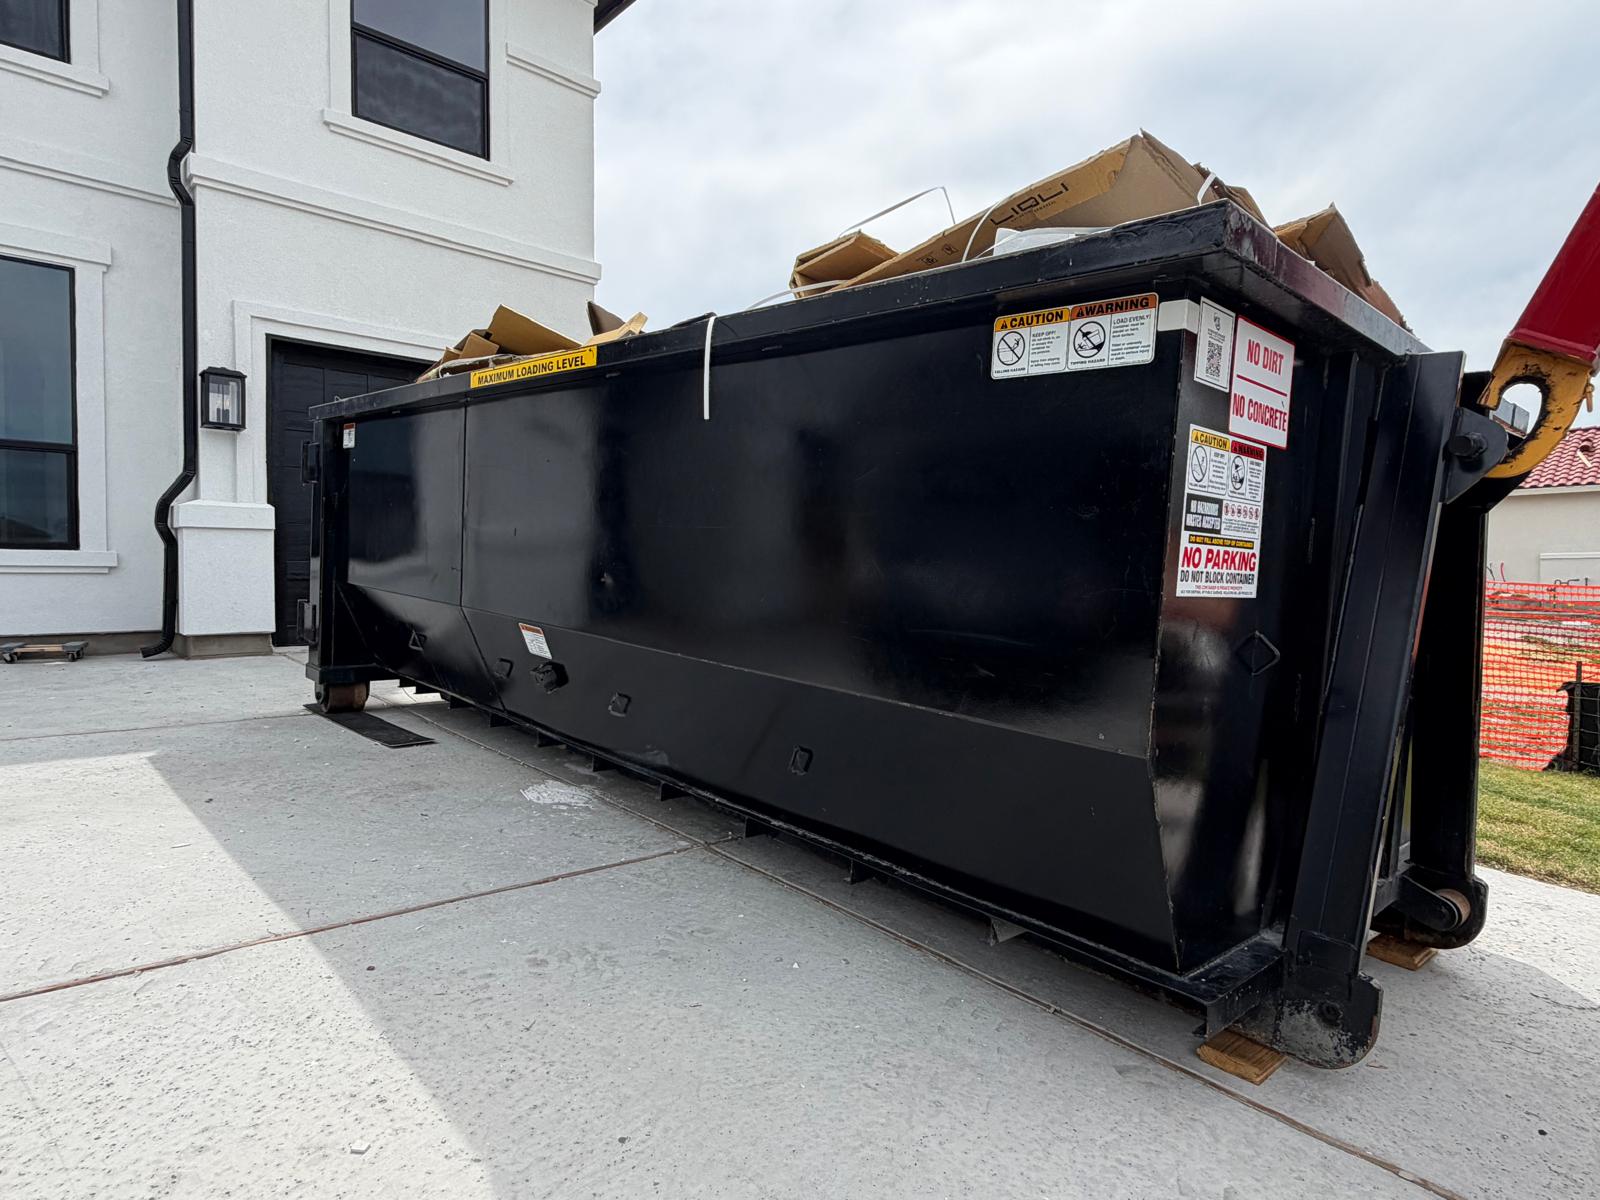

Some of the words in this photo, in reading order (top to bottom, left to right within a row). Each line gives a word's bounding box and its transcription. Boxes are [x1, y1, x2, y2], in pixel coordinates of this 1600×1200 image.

[1085, 297, 1149, 315] WARNING
[1010, 311, 1064, 328] CAUTION
[1247, 339, 1260, 366] NO
[1262, 346, 1284, 376] DIRT
[478, 370, 514, 385] MAXIMUM
[517, 364, 554, 378] LOADING
[556, 356, 586, 370] LEVEL
[1232, 393, 1246, 418] NO
[1248, 398, 1287, 432] CONCRETE
[1200, 434, 1227, 449] CAUTION
[1181, 546, 1202, 568] NO
[1204, 548, 1256, 572] PARKING
[1180, 570, 1189, 582] DO
[1191, 570, 1203, 583] NOT
[1205, 571, 1224, 584] BLOCK
[1226, 572, 1254, 585] CONTAINER
